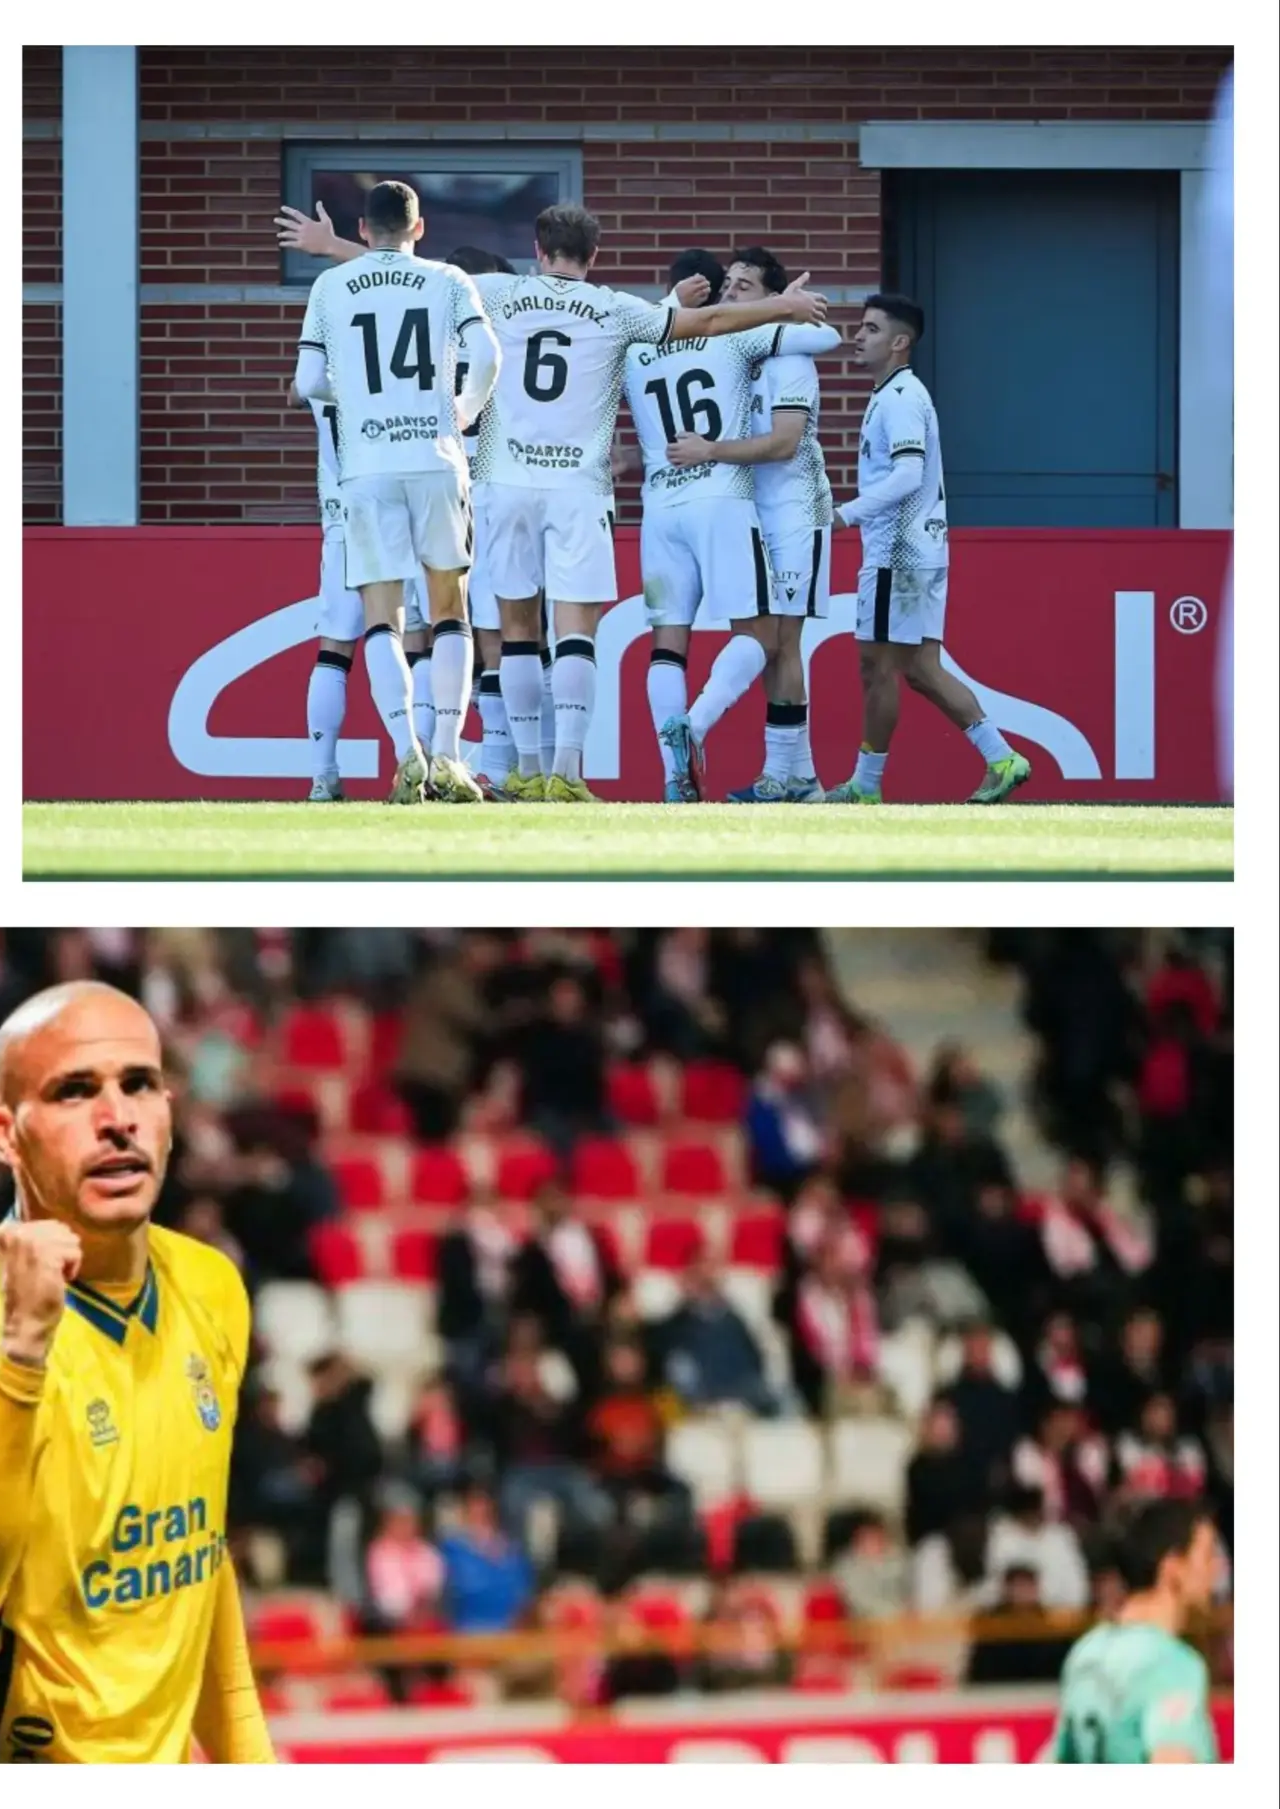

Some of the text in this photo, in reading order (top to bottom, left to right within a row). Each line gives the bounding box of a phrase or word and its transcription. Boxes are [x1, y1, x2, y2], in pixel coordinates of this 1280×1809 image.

[346, 271, 426, 295] BODIGER
[503, 296, 566, 320] CARLOS
[350, 307, 436, 395] 14
[523, 329, 572, 402] 6
[645, 368, 723, 443] 16
[385, 415, 438, 429] DARYSO
[389, 429, 438, 442] MOTOR
[525, 444, 584, 458] DARYSO
[526, 455, 581, 468] MOTOR
[111, 1496, 206, 1553] Gran
